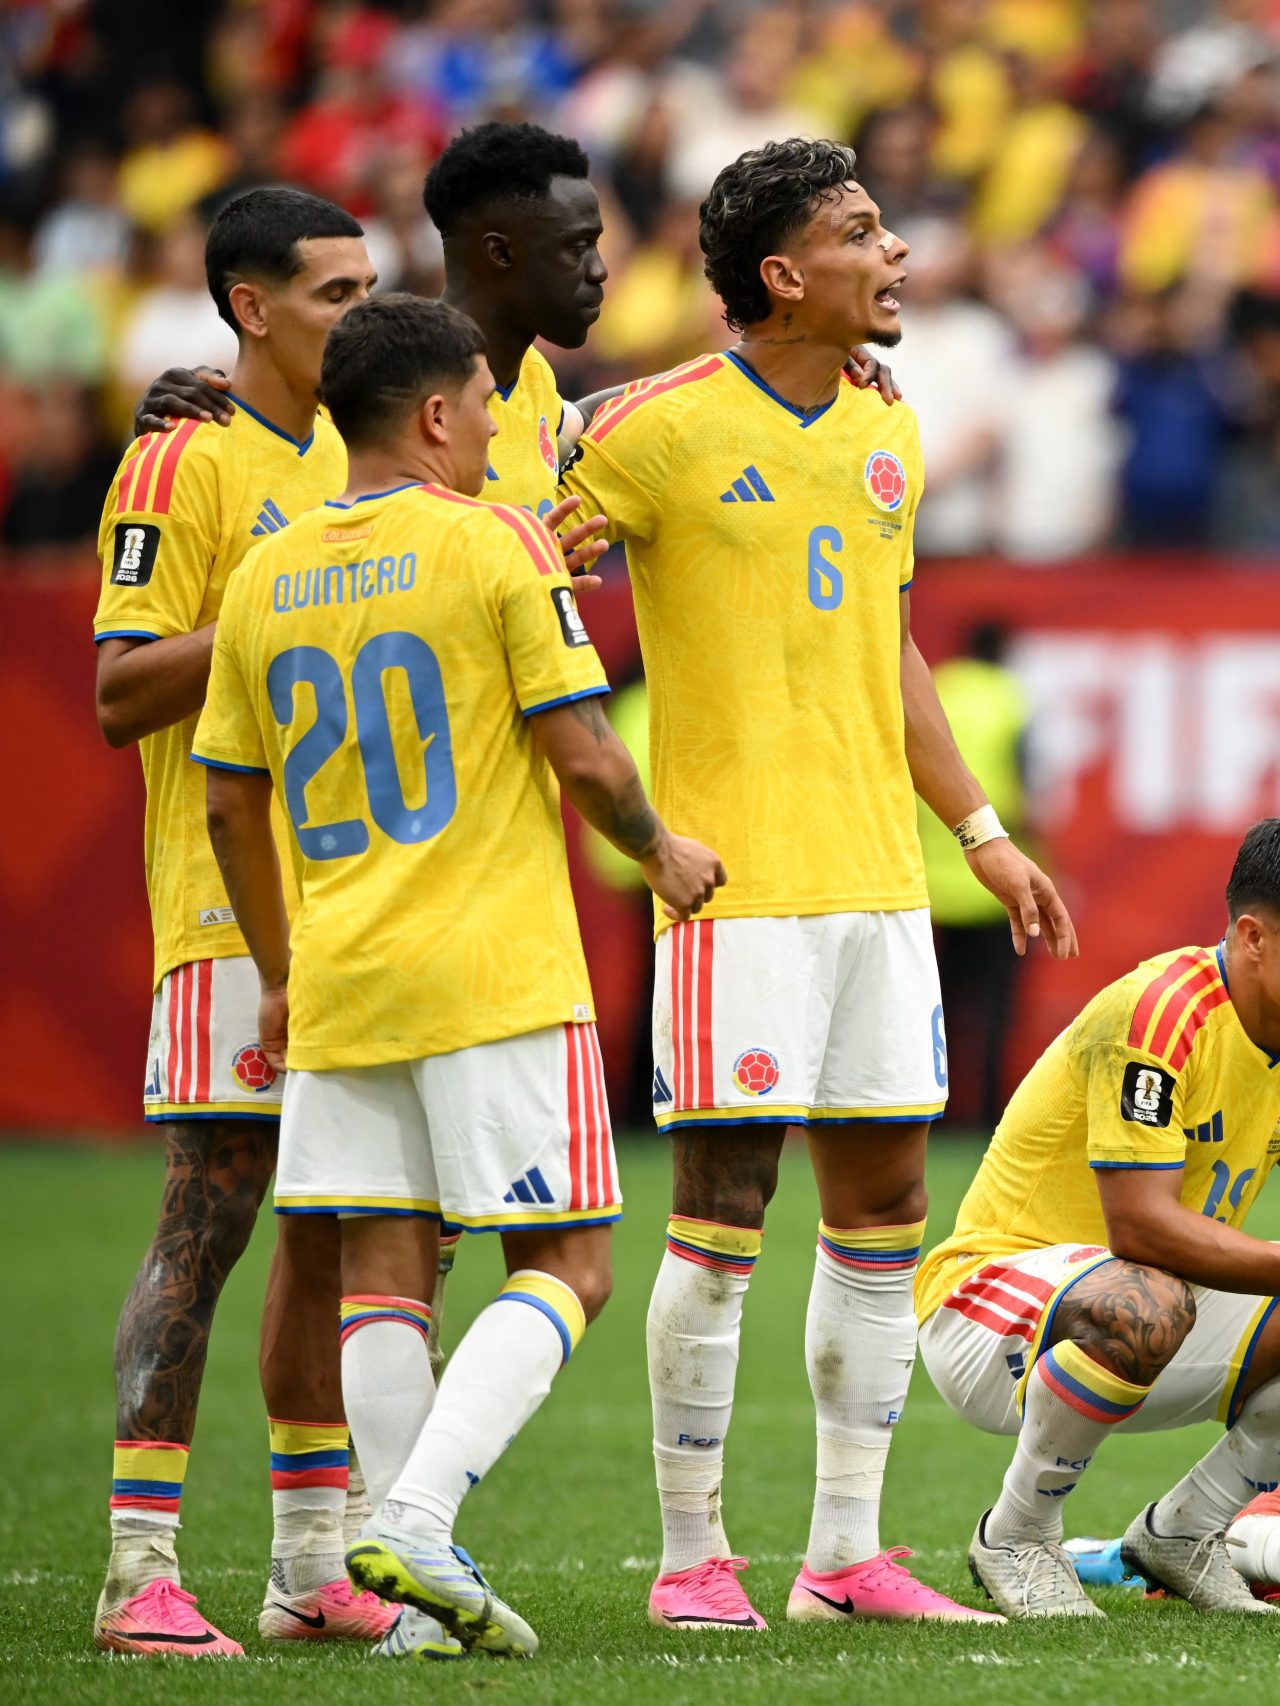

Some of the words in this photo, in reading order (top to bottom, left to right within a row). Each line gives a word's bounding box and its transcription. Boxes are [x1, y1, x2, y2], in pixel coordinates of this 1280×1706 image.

[273, 552, 416, 613] QUINTERO
[808, 525, 843, 610] 6
[267, 631, 457, 861] 20
